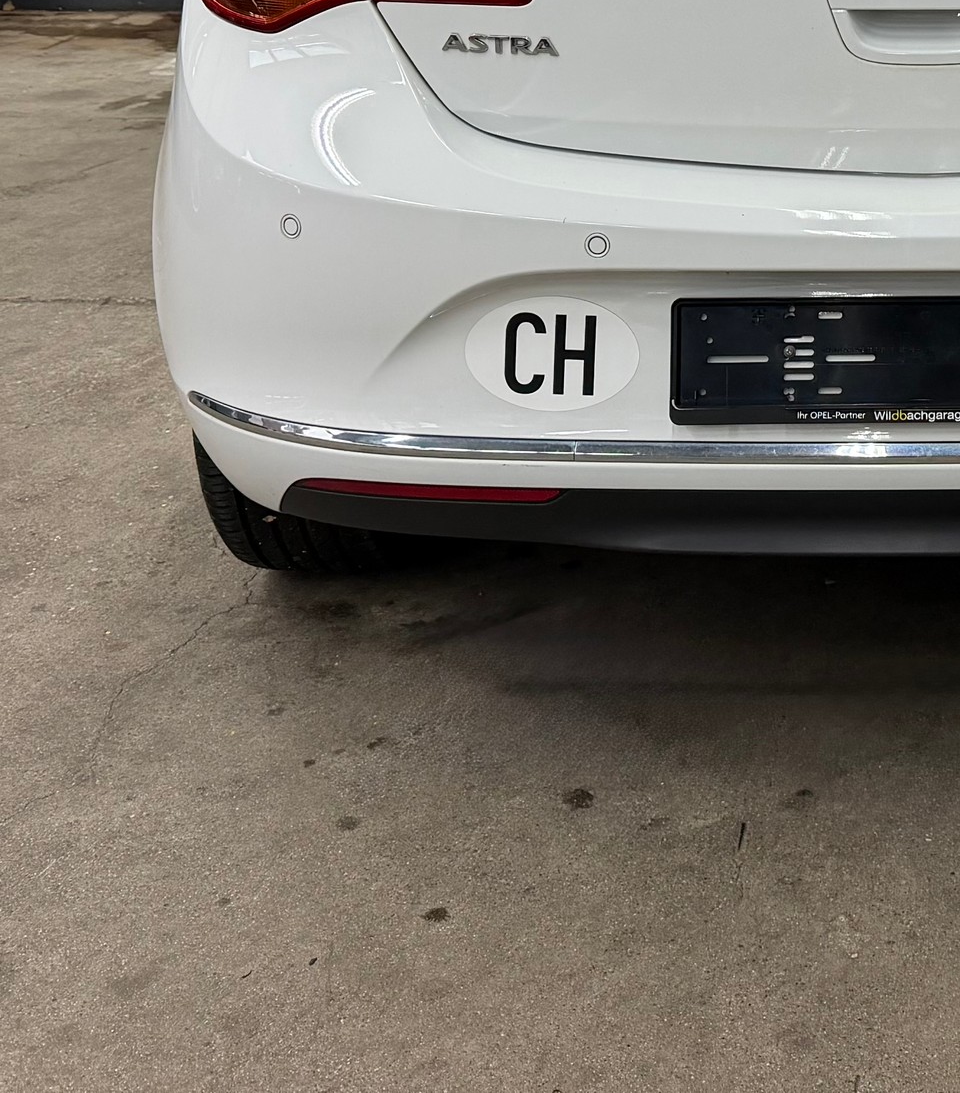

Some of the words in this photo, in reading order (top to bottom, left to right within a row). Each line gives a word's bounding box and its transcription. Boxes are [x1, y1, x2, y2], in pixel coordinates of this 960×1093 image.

[441, 32, 560, 57] ASTRA
[504, 311, 597, 396] CH
[796, 410, 808, 420] Ihr
[810, 410, 866, 420] OPEL-Partner
